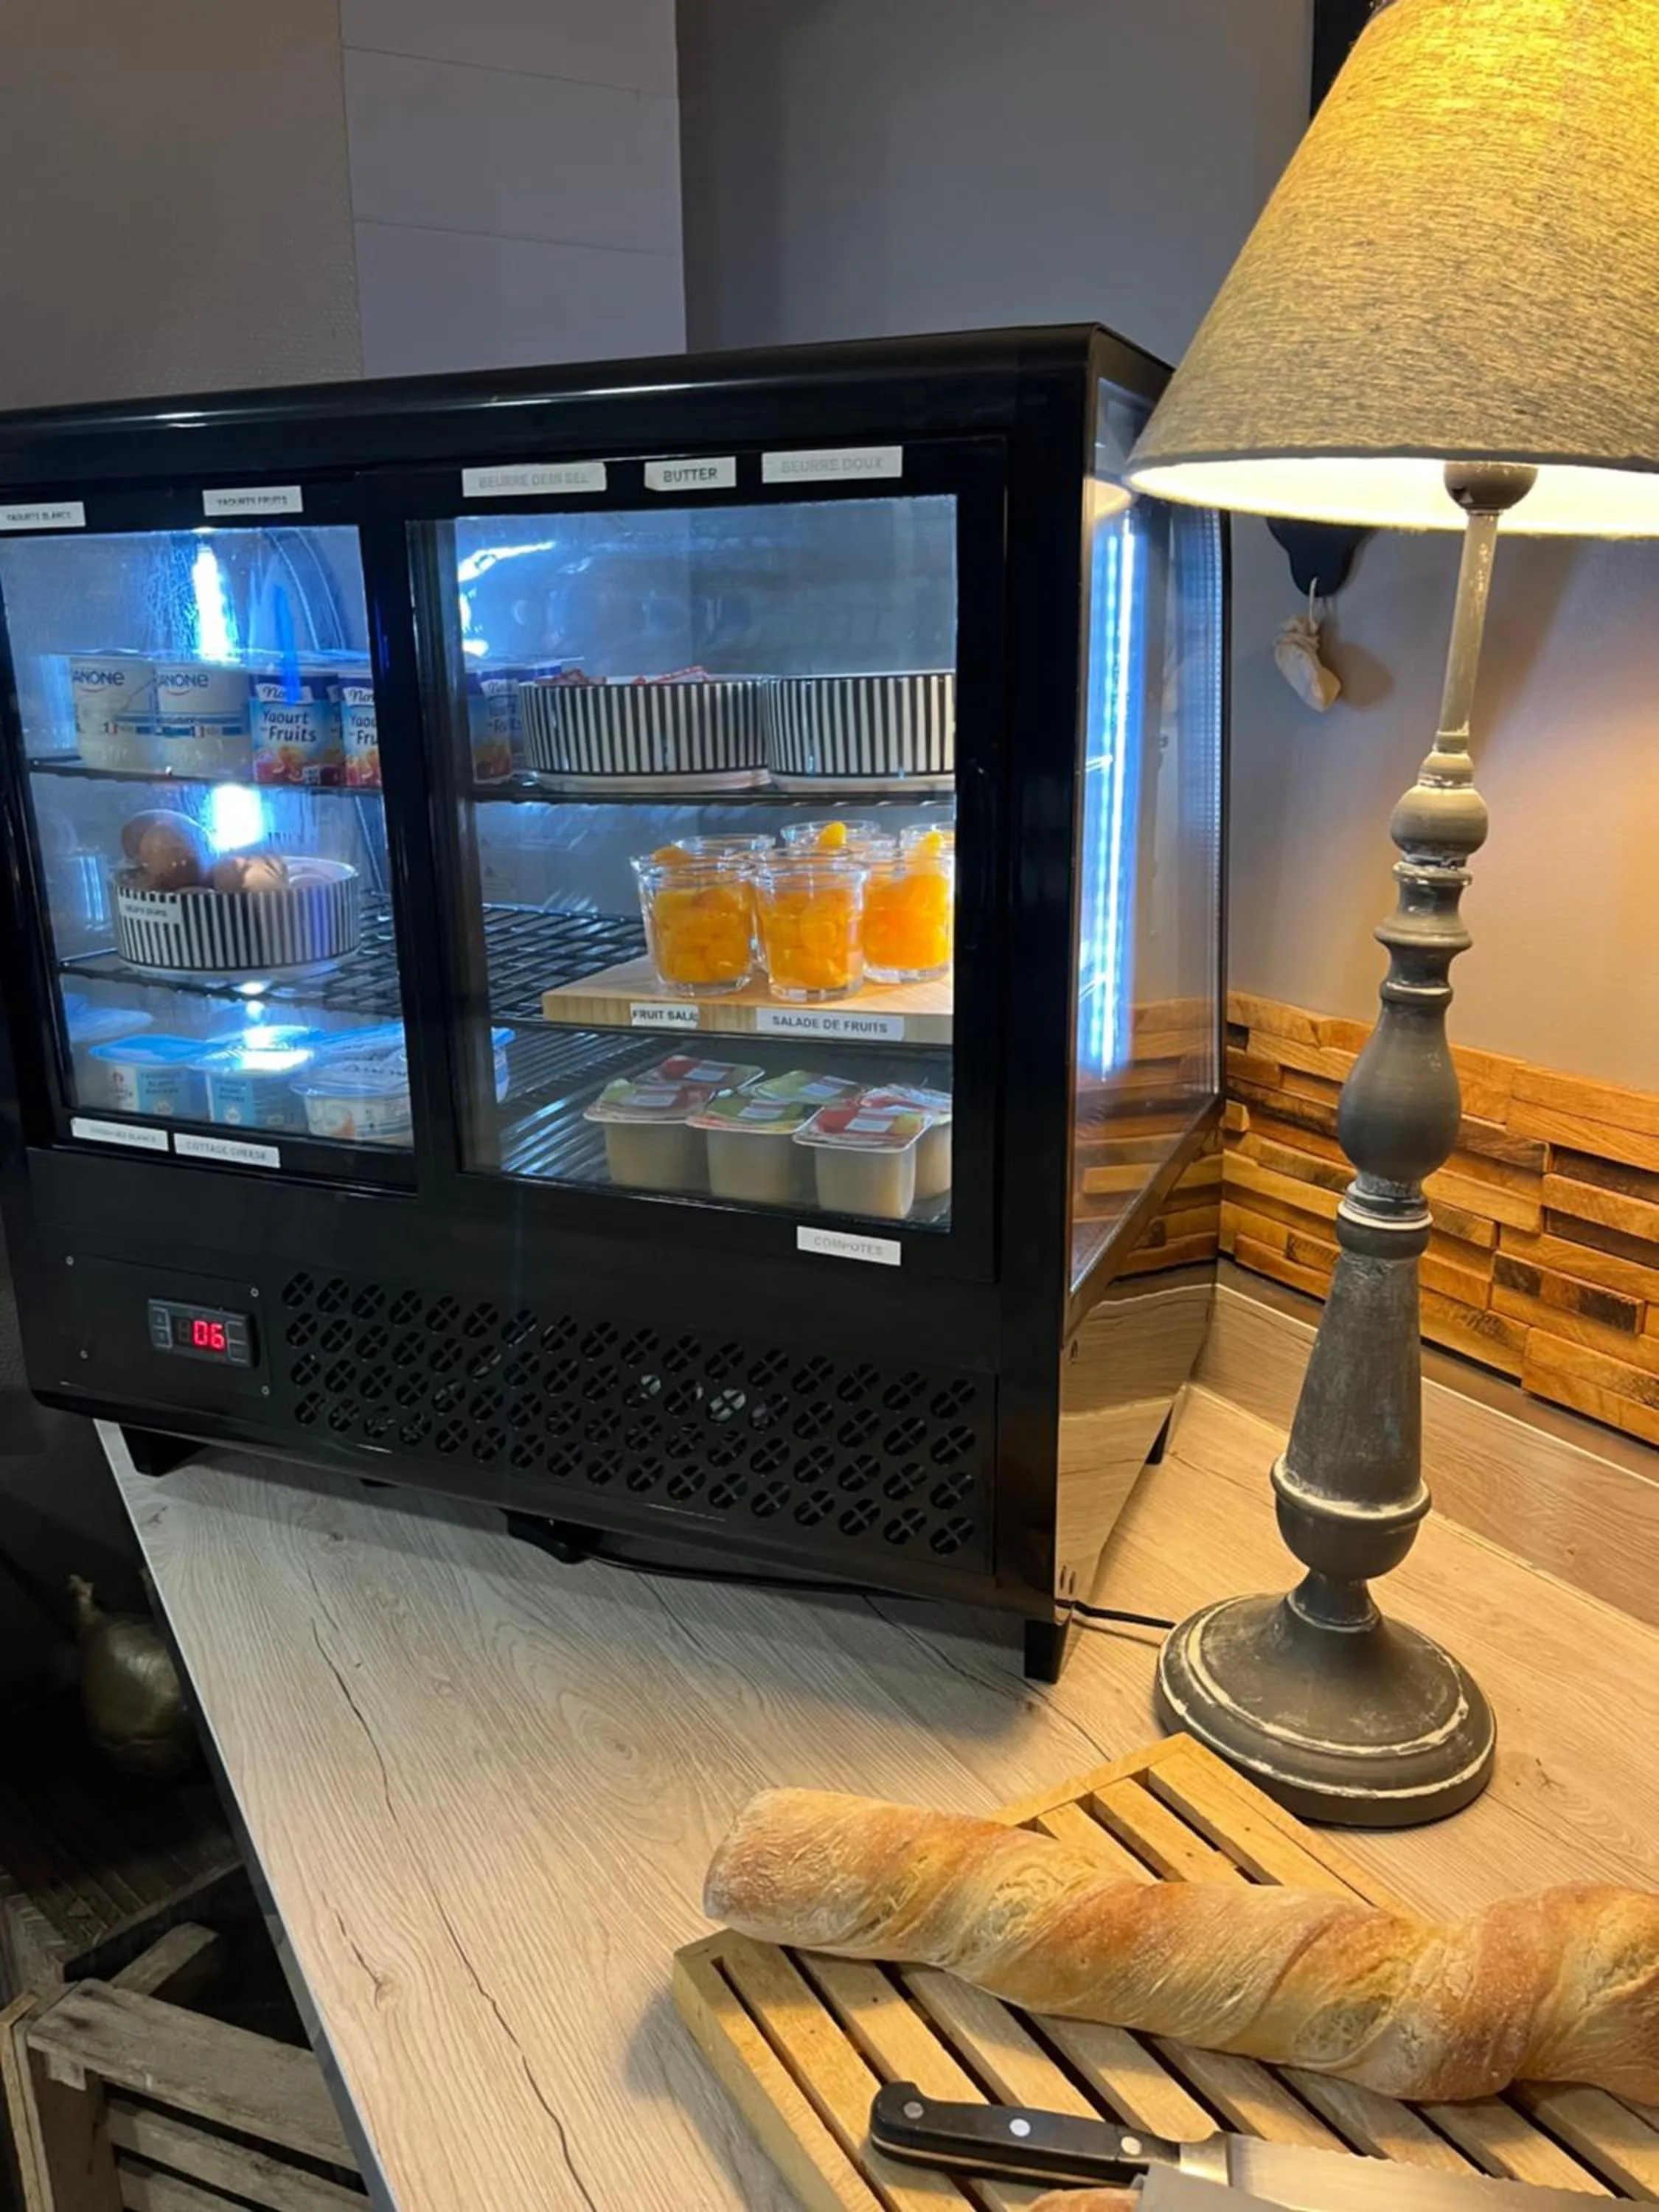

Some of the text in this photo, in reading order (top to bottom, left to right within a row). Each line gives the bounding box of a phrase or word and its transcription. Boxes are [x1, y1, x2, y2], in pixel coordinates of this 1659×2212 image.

[780, 459, 838, 474] BEURRE
[663, 467, 718, 483] BUTTER
[262, 709, 308, 725] Yaourt
[268, 725, 317, 743] Fruits
[633, 1010, 664, 1021] FRUIT
[772, 1015, 888, 1034] SALADE DE FRUITS
[193, 1320, 225, 1349] 06
